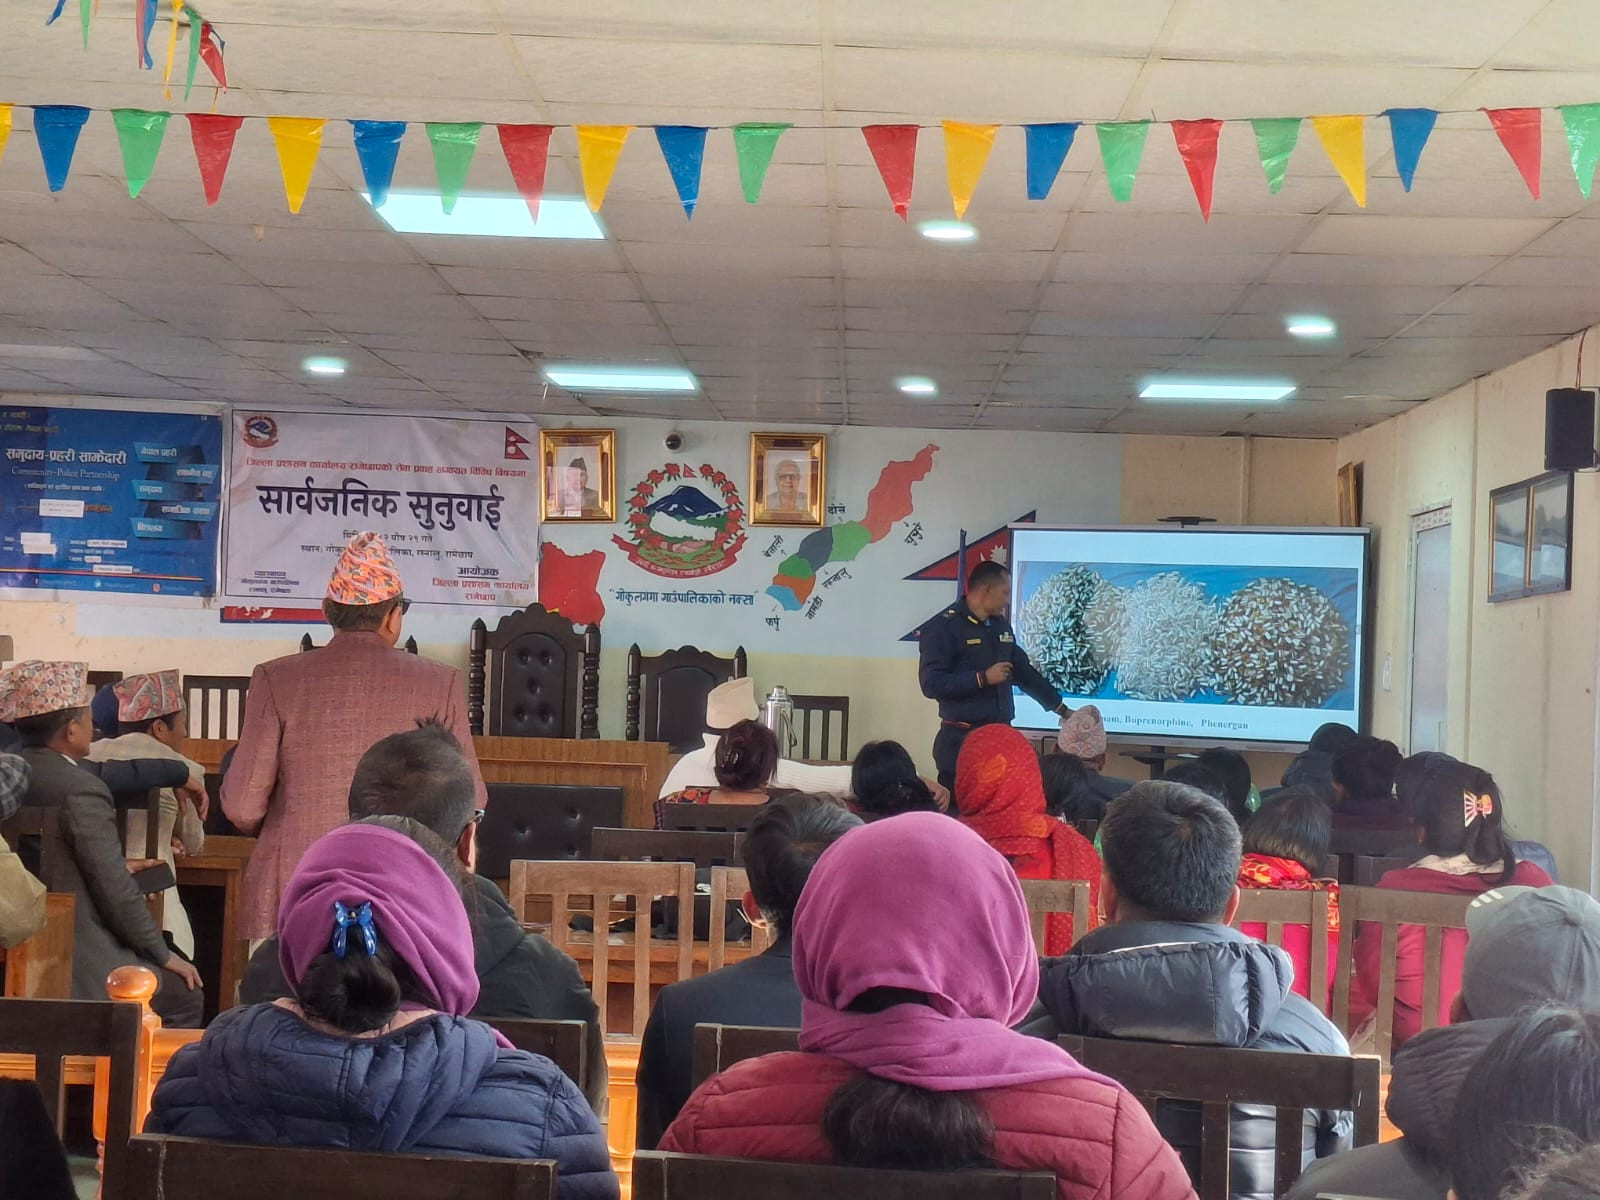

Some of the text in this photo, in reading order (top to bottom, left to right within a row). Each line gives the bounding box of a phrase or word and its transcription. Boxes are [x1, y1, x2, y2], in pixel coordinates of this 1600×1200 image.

[276, 460, 306, 469] प्रशासन
[309, 459, 346, 470] कार्यालय
[256, 476, 504, 531] सार्वजनिक सुनुवाई
[457, 565, 500, 576] आयोजक
[1201, 718, 1248, 729] Phenergan
